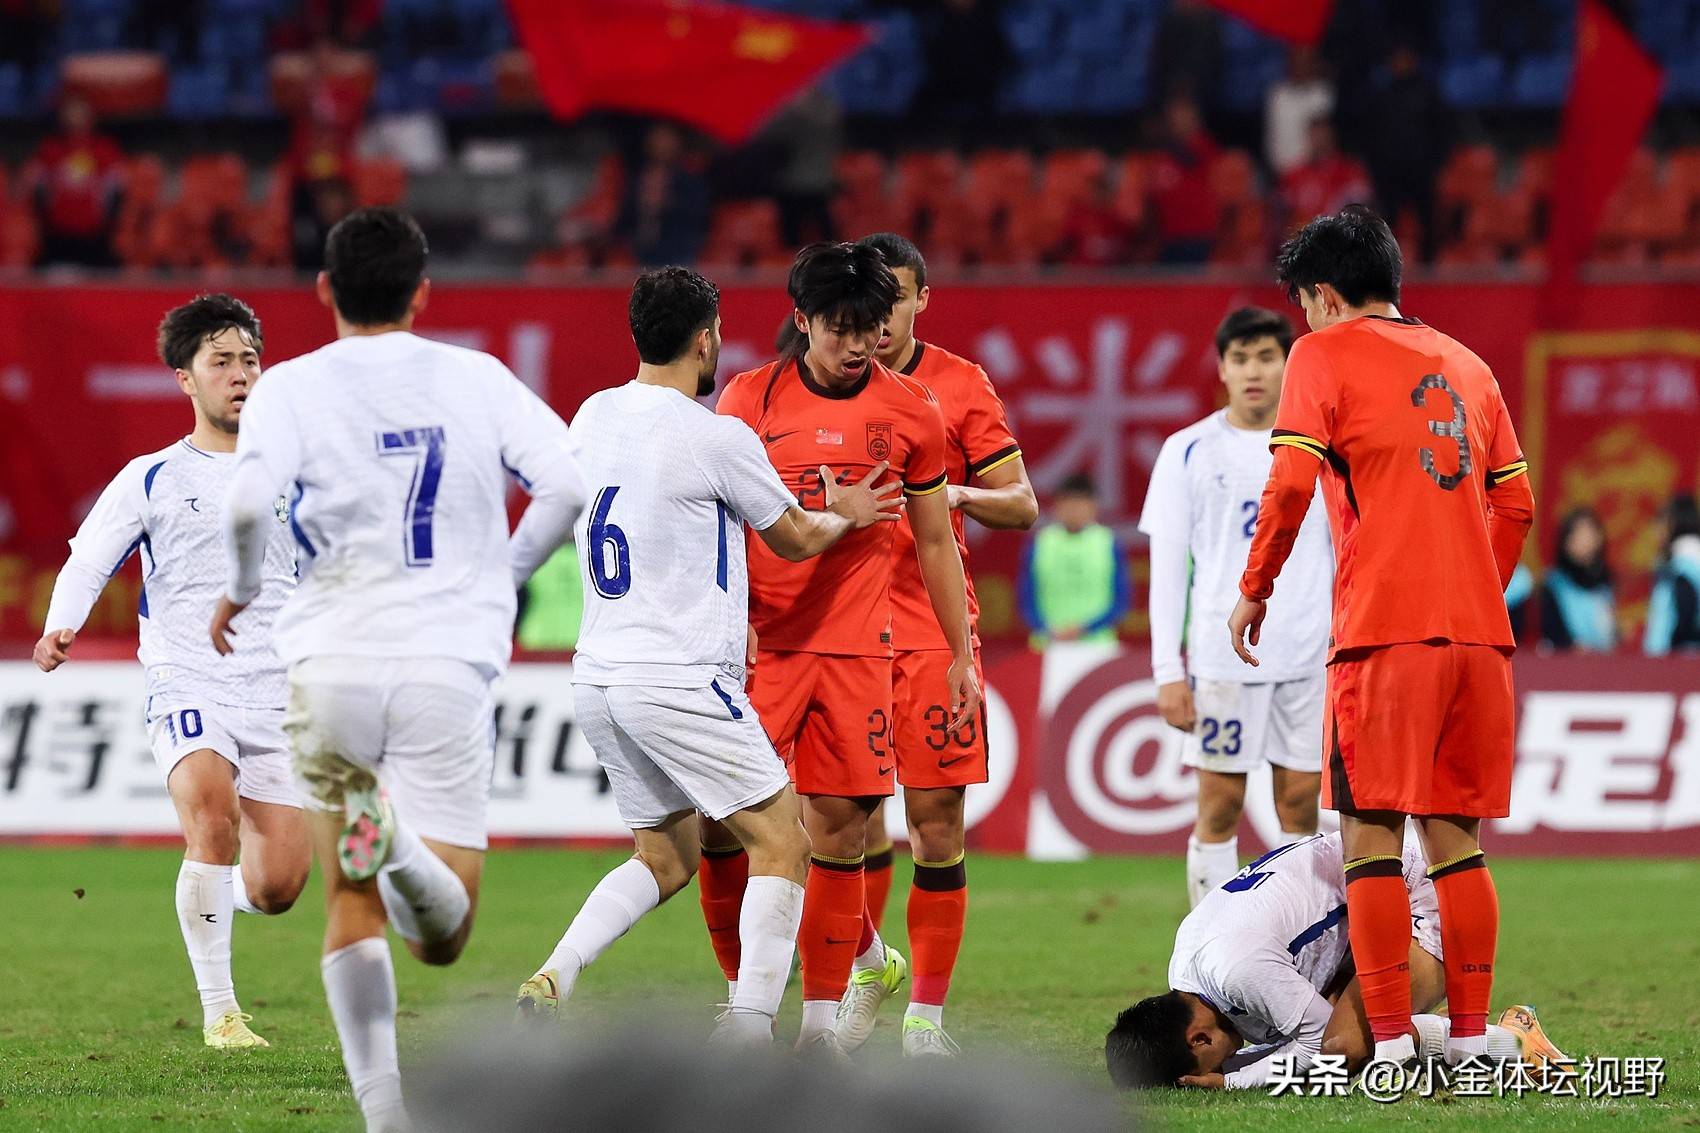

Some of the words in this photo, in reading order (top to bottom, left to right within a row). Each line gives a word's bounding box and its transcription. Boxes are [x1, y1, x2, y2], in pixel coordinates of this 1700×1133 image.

[1411, 373, 1472, 491] 3
[376, 426, 446, 567] 7
[587, 485, 631, 600] 6
[164, 709, 203, 748] 10
[1202, 717, 1242, 756] 23
[1494, 690, 1700, 833] 足
